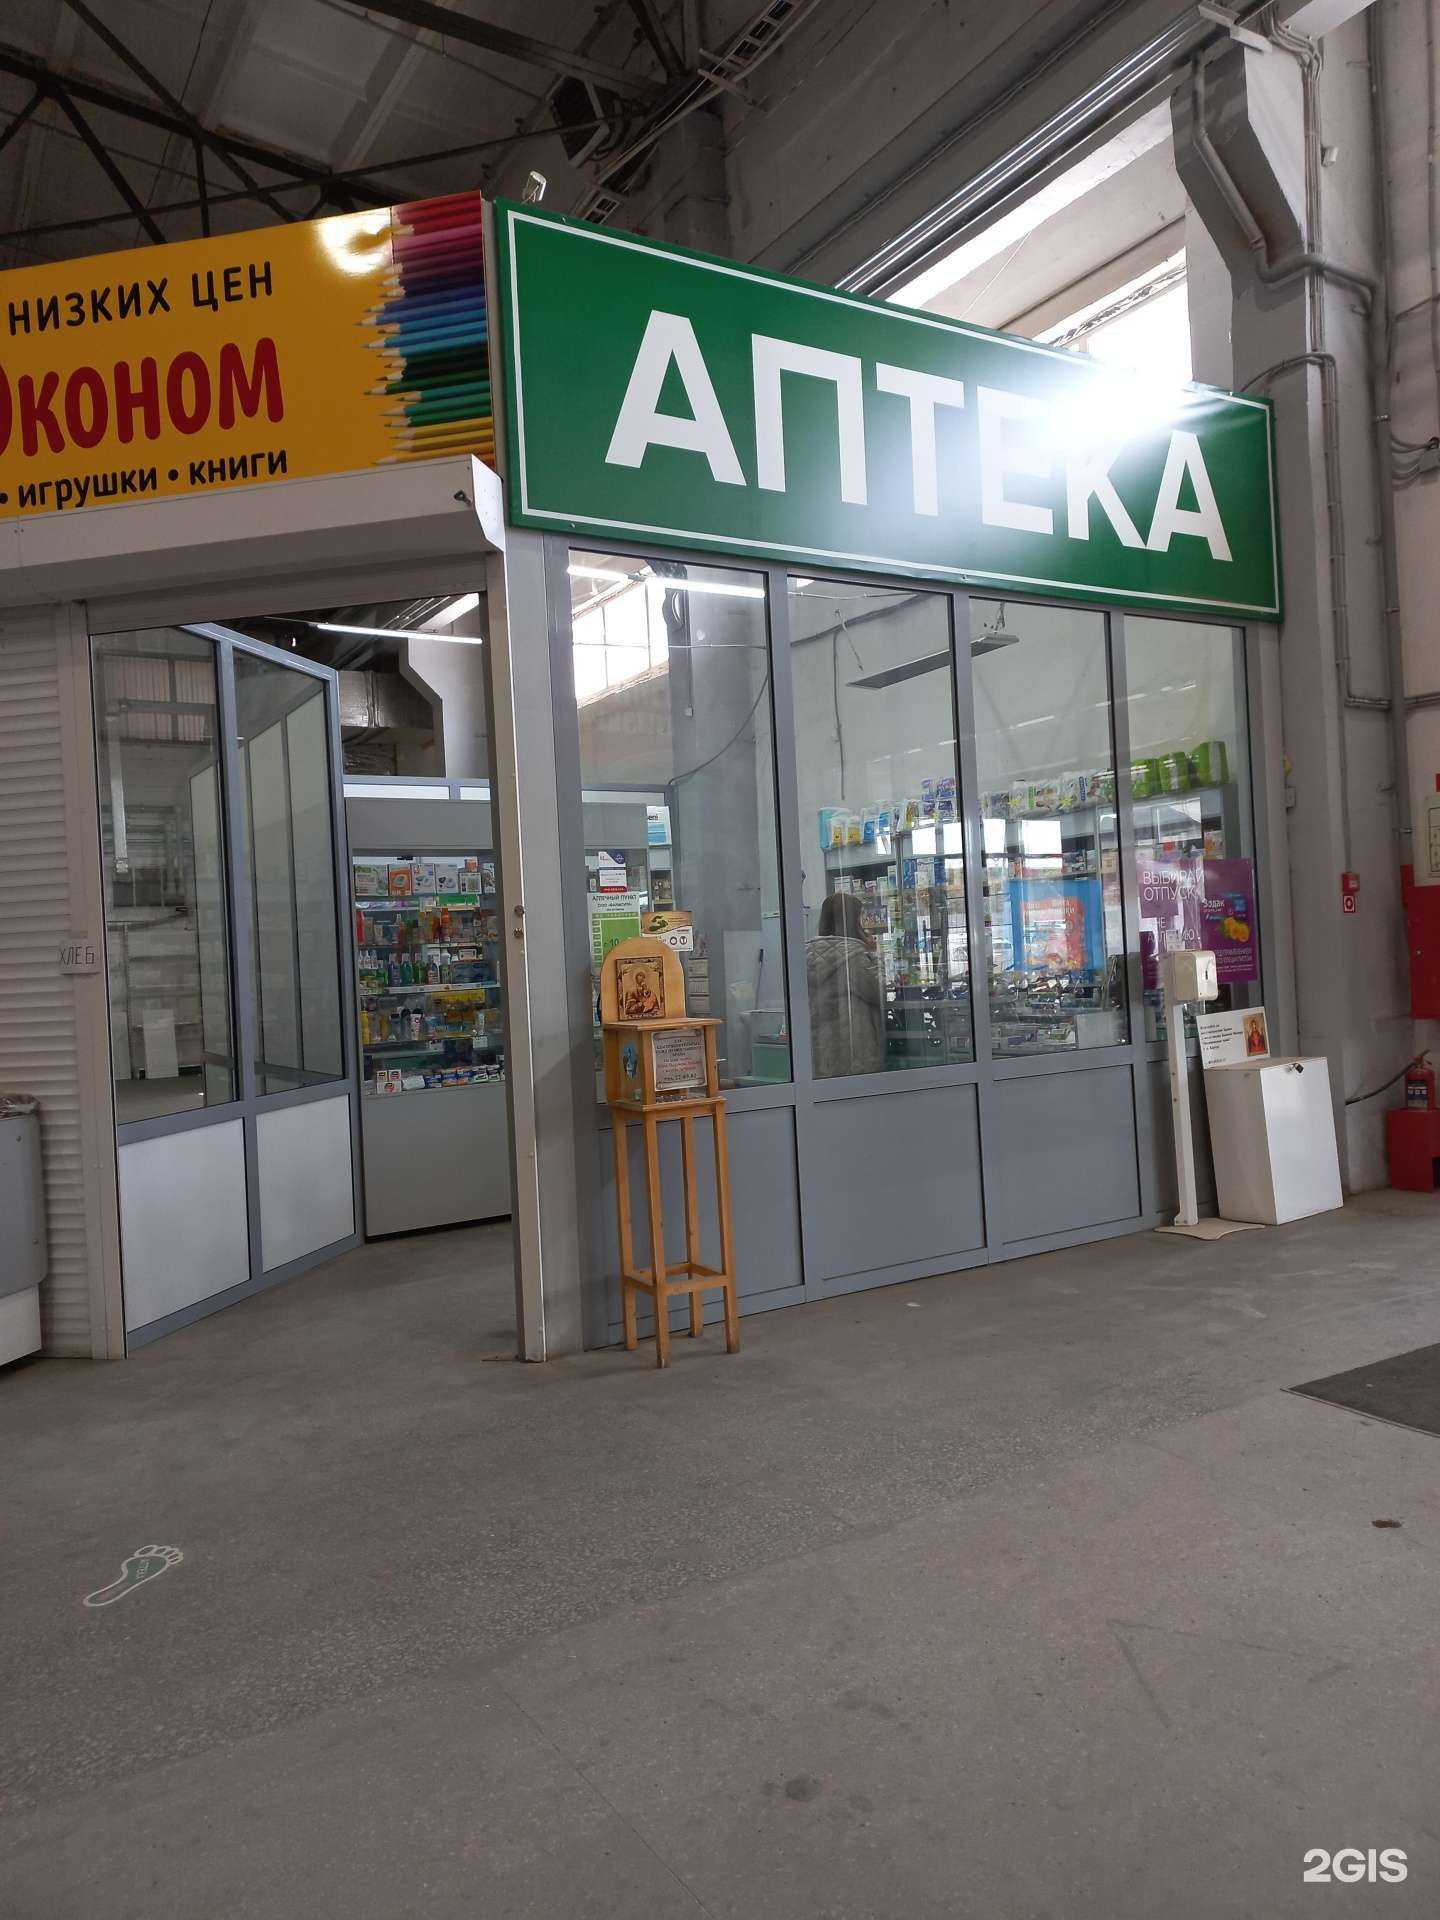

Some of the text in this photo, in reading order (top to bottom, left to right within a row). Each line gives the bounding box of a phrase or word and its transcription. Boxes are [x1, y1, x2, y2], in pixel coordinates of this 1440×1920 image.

[8, 261, 273, 336] НИЗКИХ ЦЕН
[605, 309, 1233, 563] АПТЕКА
[18, 450, 288, 511] игрушки книги
[1143, 867, 1204, 885] ВЫБИРАЙ
[60, 946, 95, 966] ХЛЕБ
